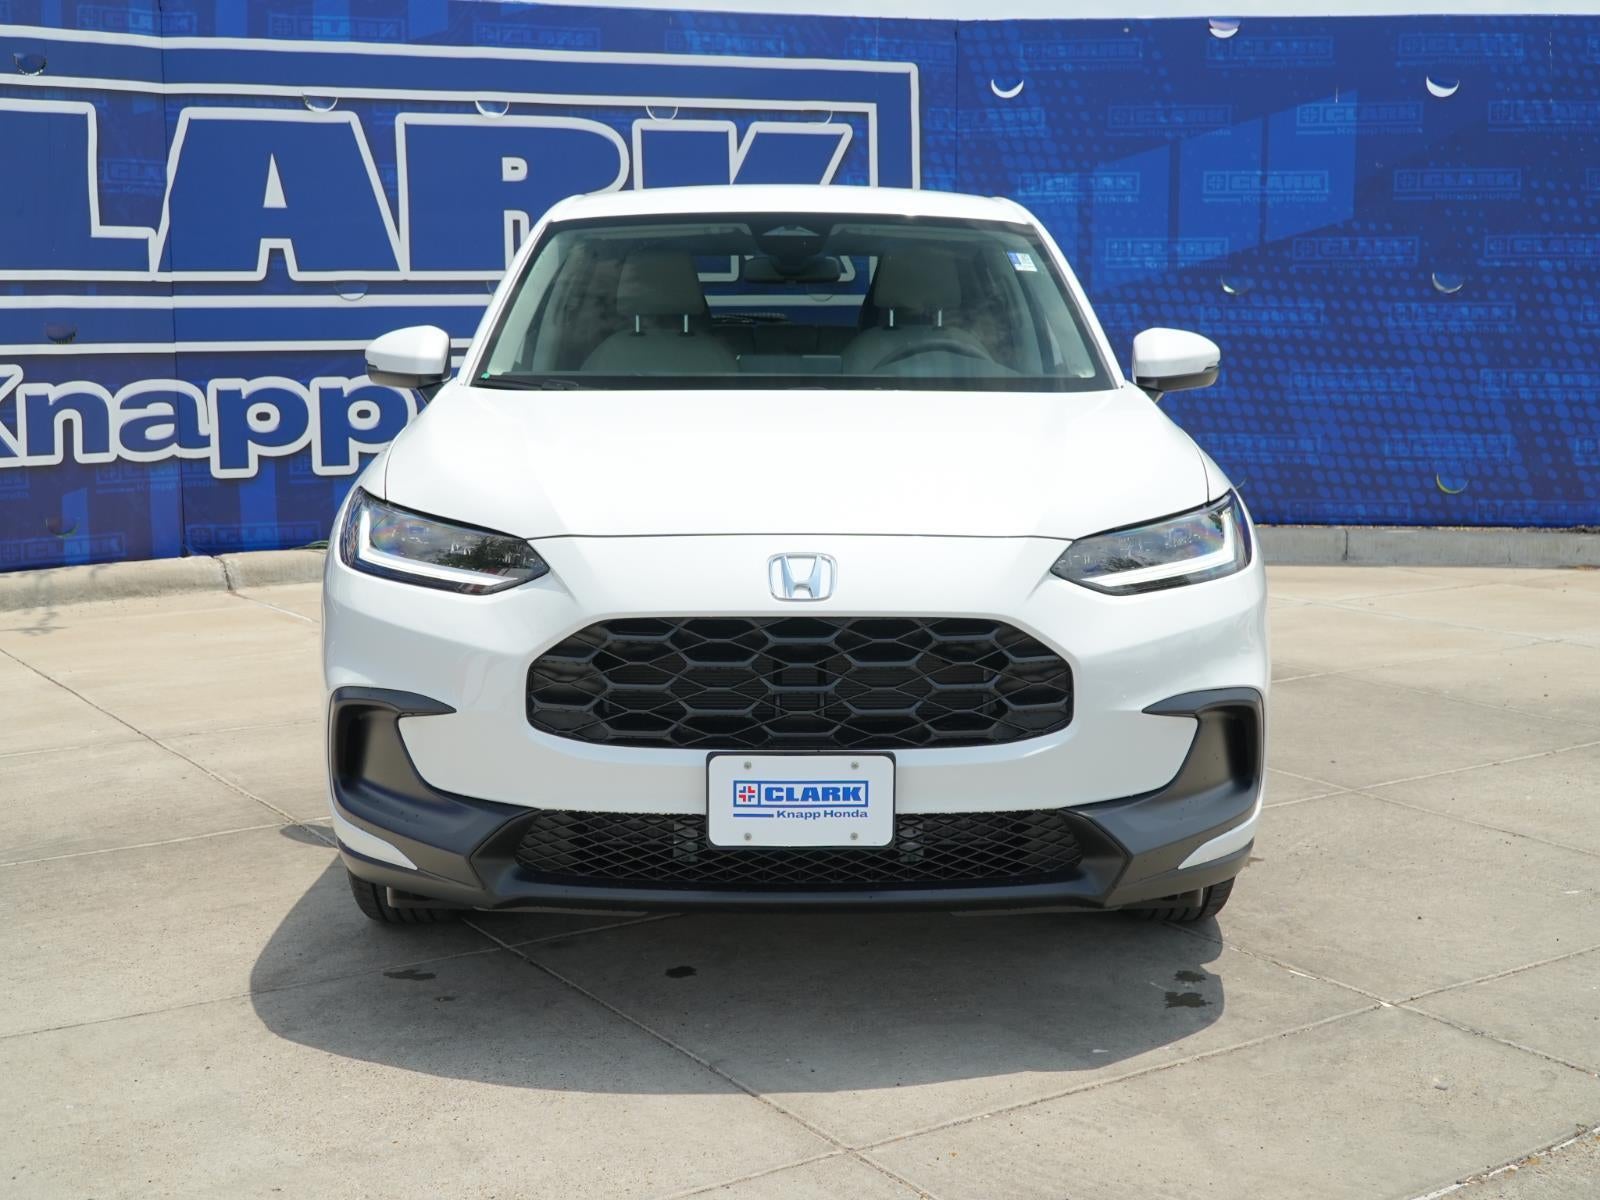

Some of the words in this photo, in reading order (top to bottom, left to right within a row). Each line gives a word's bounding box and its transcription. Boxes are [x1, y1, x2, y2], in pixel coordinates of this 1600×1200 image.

[0, 363, 419, 479] napp
[764, 786, 862, 802] CLARK
[776, 810, 821, 820] Knapp
[823, 809, 868, 819] Honda
